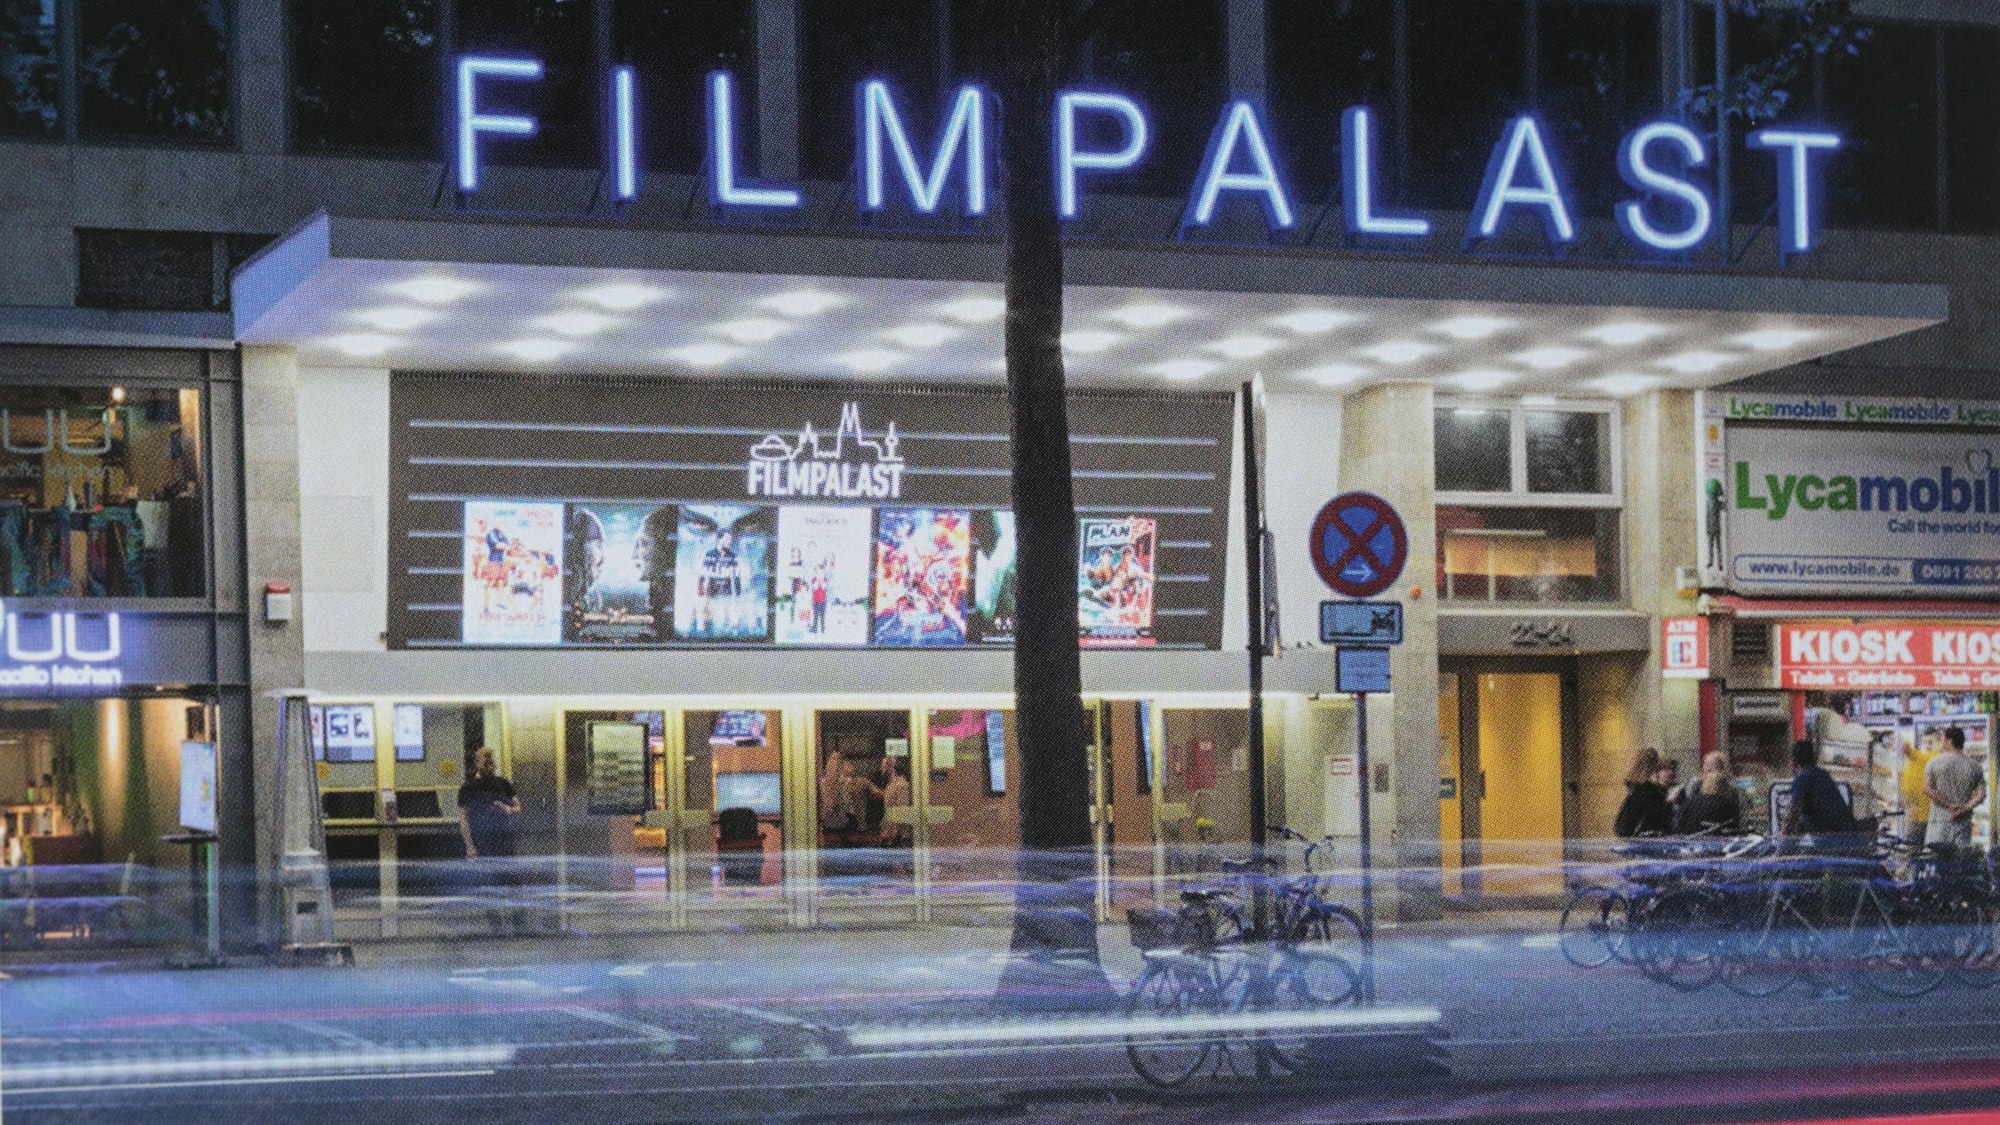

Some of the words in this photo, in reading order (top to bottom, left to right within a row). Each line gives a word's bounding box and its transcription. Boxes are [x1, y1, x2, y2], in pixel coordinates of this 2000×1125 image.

[457, 56, 1842, 253] FILMPALAST
[1730, 399, 1837, 419] Lycamobile
[1844, 401, 1950, 422] Lycamobile
[747, 461, 904, 498] FILMPALAST
[1734, 460, 2000, 521] Lycamobil
[1090, 524, 1131, 539] PLAN
[1888, 519, 1914, 533] Call
[1918, 519, 1940, 533] the
[1942, 520, 1981, 534] world
[1749, 561, 1900, 577] www.lycamobile.de
[1667, 620, 1698, 633] ATM
[1790, 630, 1914, 664] KIOSK
